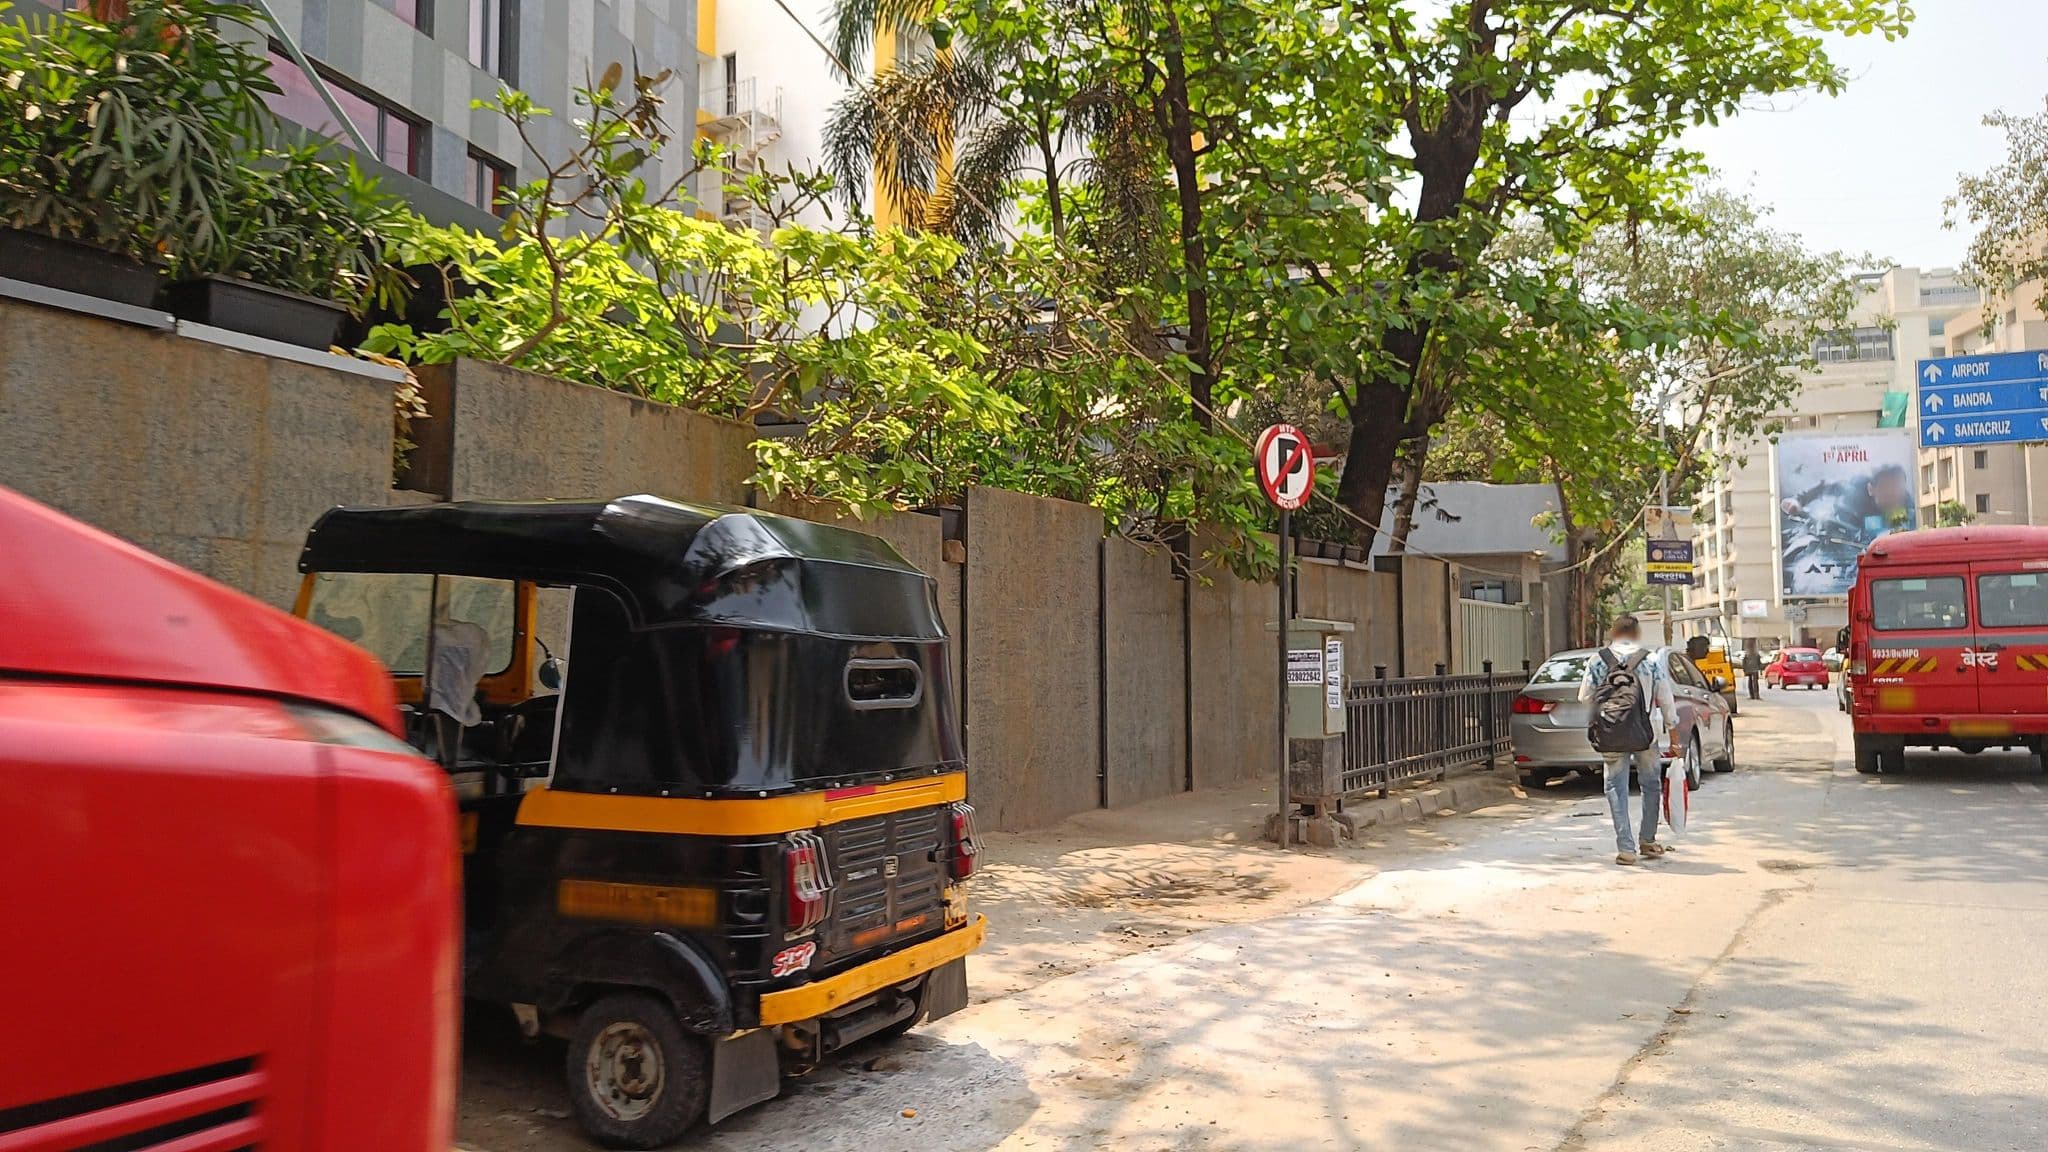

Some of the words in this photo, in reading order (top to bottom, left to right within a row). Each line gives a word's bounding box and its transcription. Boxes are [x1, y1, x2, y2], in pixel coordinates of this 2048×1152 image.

[1951, 362, 1990, 378] AIRPORT
[1953, 391, 1993, 408] BANDRA
[1954, 420, 2011, 437] SANTACRUZ
[1837, 449, 1870, 463] APRIL
[1804, 563, 1853, 574] ATT
[1960, 647, 1998, 668] बेस्ट
